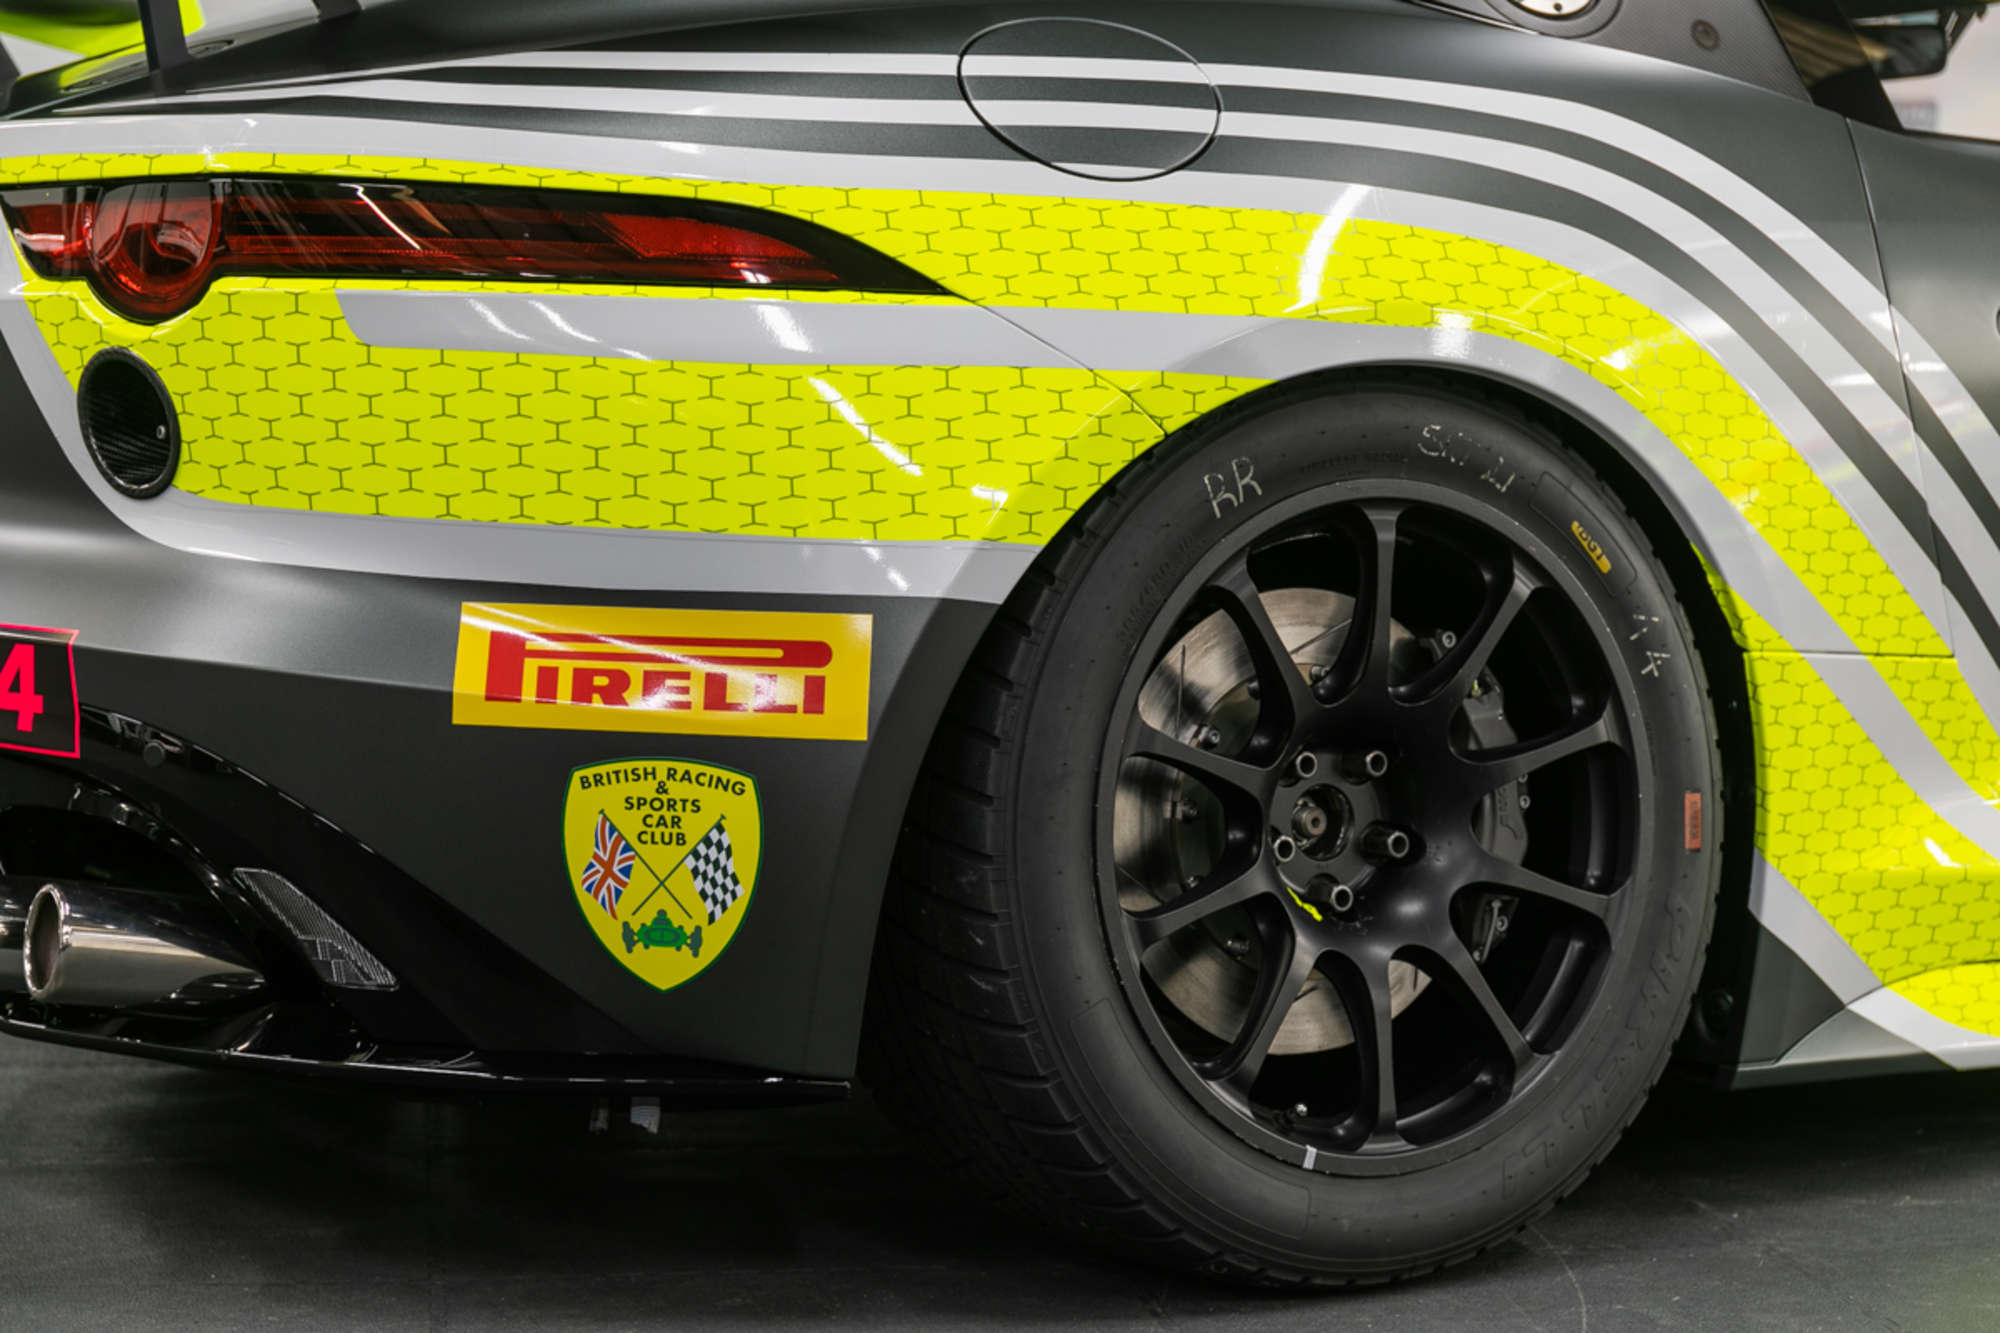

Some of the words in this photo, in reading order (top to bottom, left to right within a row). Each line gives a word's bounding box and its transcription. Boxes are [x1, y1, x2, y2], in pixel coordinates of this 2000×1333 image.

[1203, 458, 1263, 519] RR
[485, 630, 833, 714] PIRELLI
[0, 643, 43, 732] 4
[579, 766, 656, 790] BRITISH
[666, 767, 746, 796] RACING
[655, 781, 669, 795] &
[623, 796, 702, 813] SPORTS
[642, 813, 682, 829] CAR
[637, 830, 687, 846] CLUB
